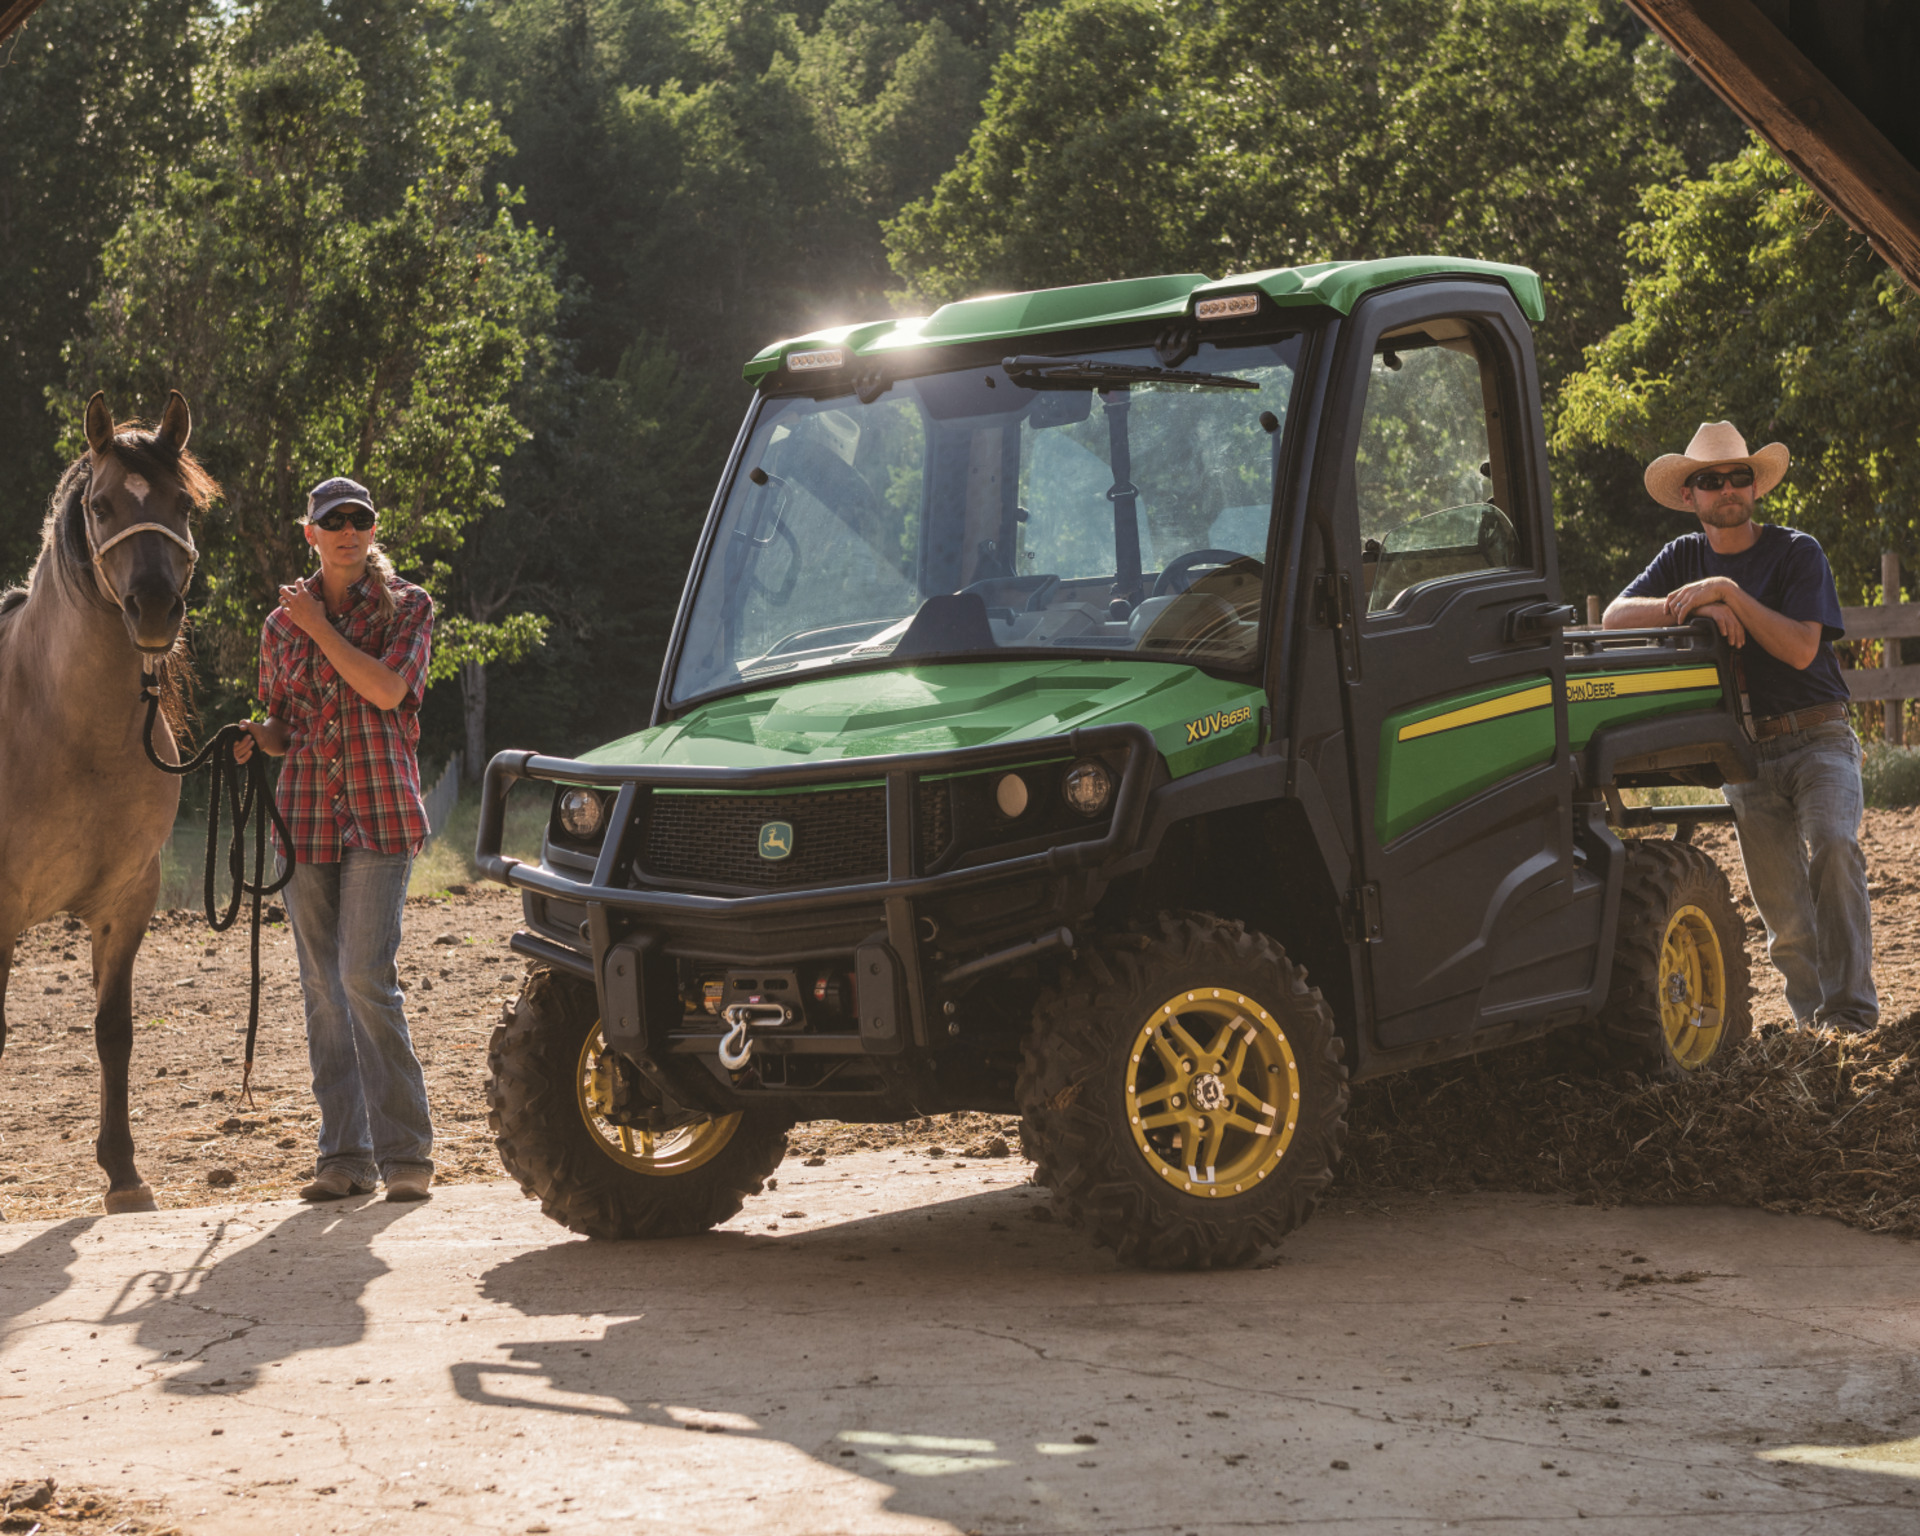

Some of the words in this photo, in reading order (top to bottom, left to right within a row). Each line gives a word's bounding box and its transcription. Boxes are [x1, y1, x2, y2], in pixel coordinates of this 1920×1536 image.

[1566, 686, 1585, 700] OHN
[1586, 682, 1616, 698] DEERE
[1185, 706, 1251, 744] XUV865R
